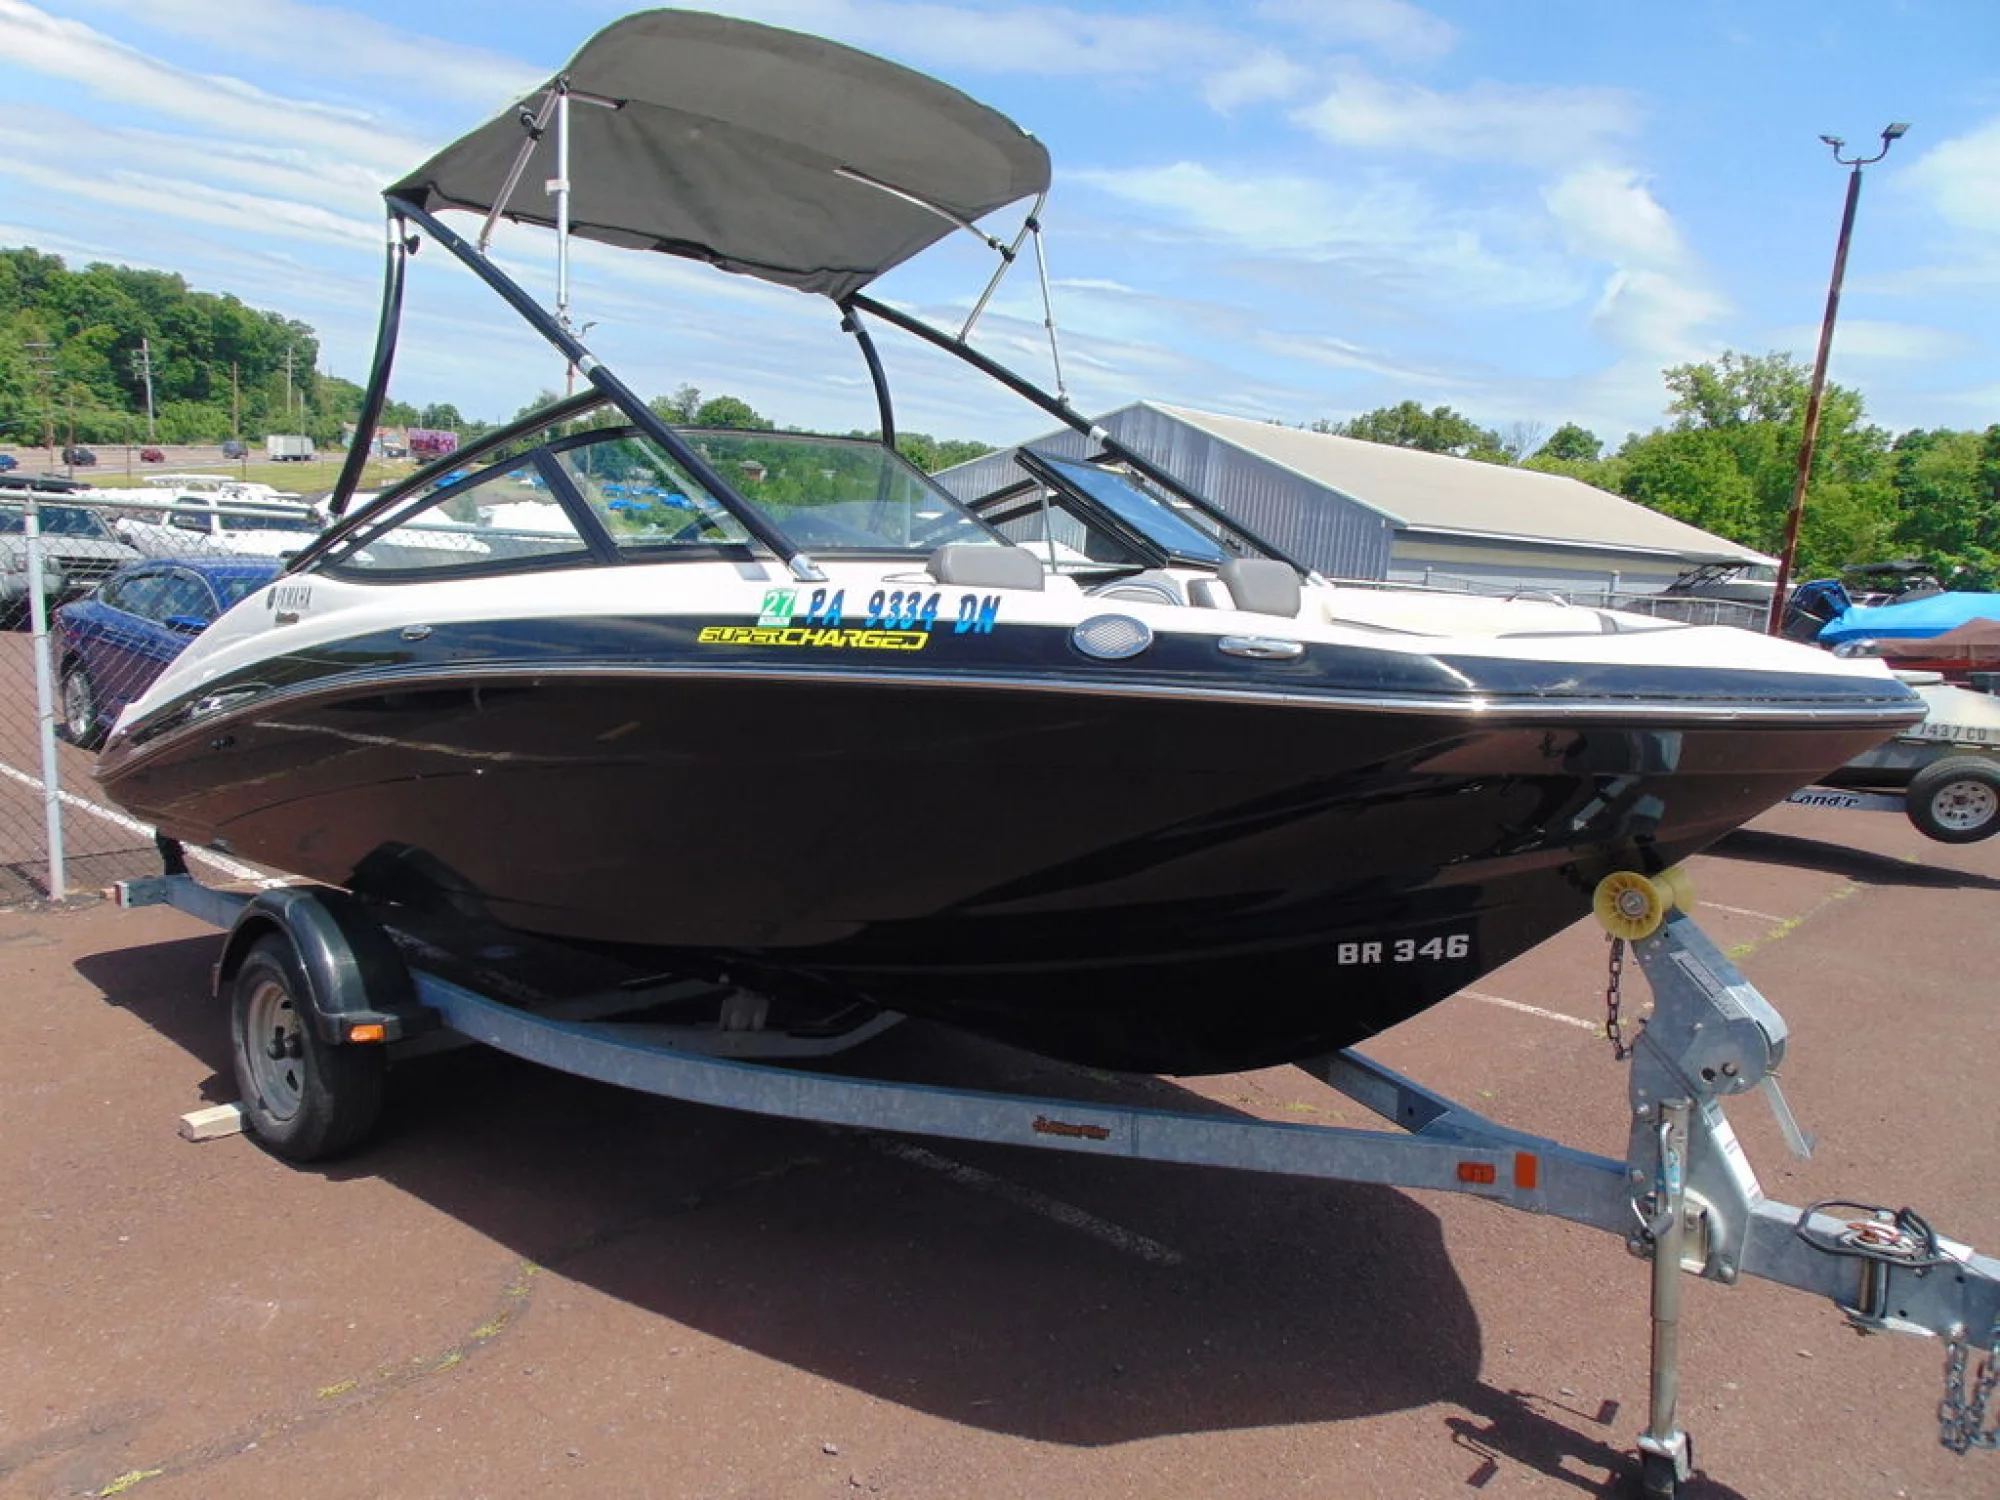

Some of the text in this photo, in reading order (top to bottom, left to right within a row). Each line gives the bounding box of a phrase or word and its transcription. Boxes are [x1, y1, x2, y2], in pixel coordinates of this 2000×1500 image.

[763, 592, 796, 616] 27
[806, 588, 1002, 634] PA 9334 DN
[697, 626, 929, 650] SUPERCHARGED
[1338, 933, 1470, 965] BR 346
